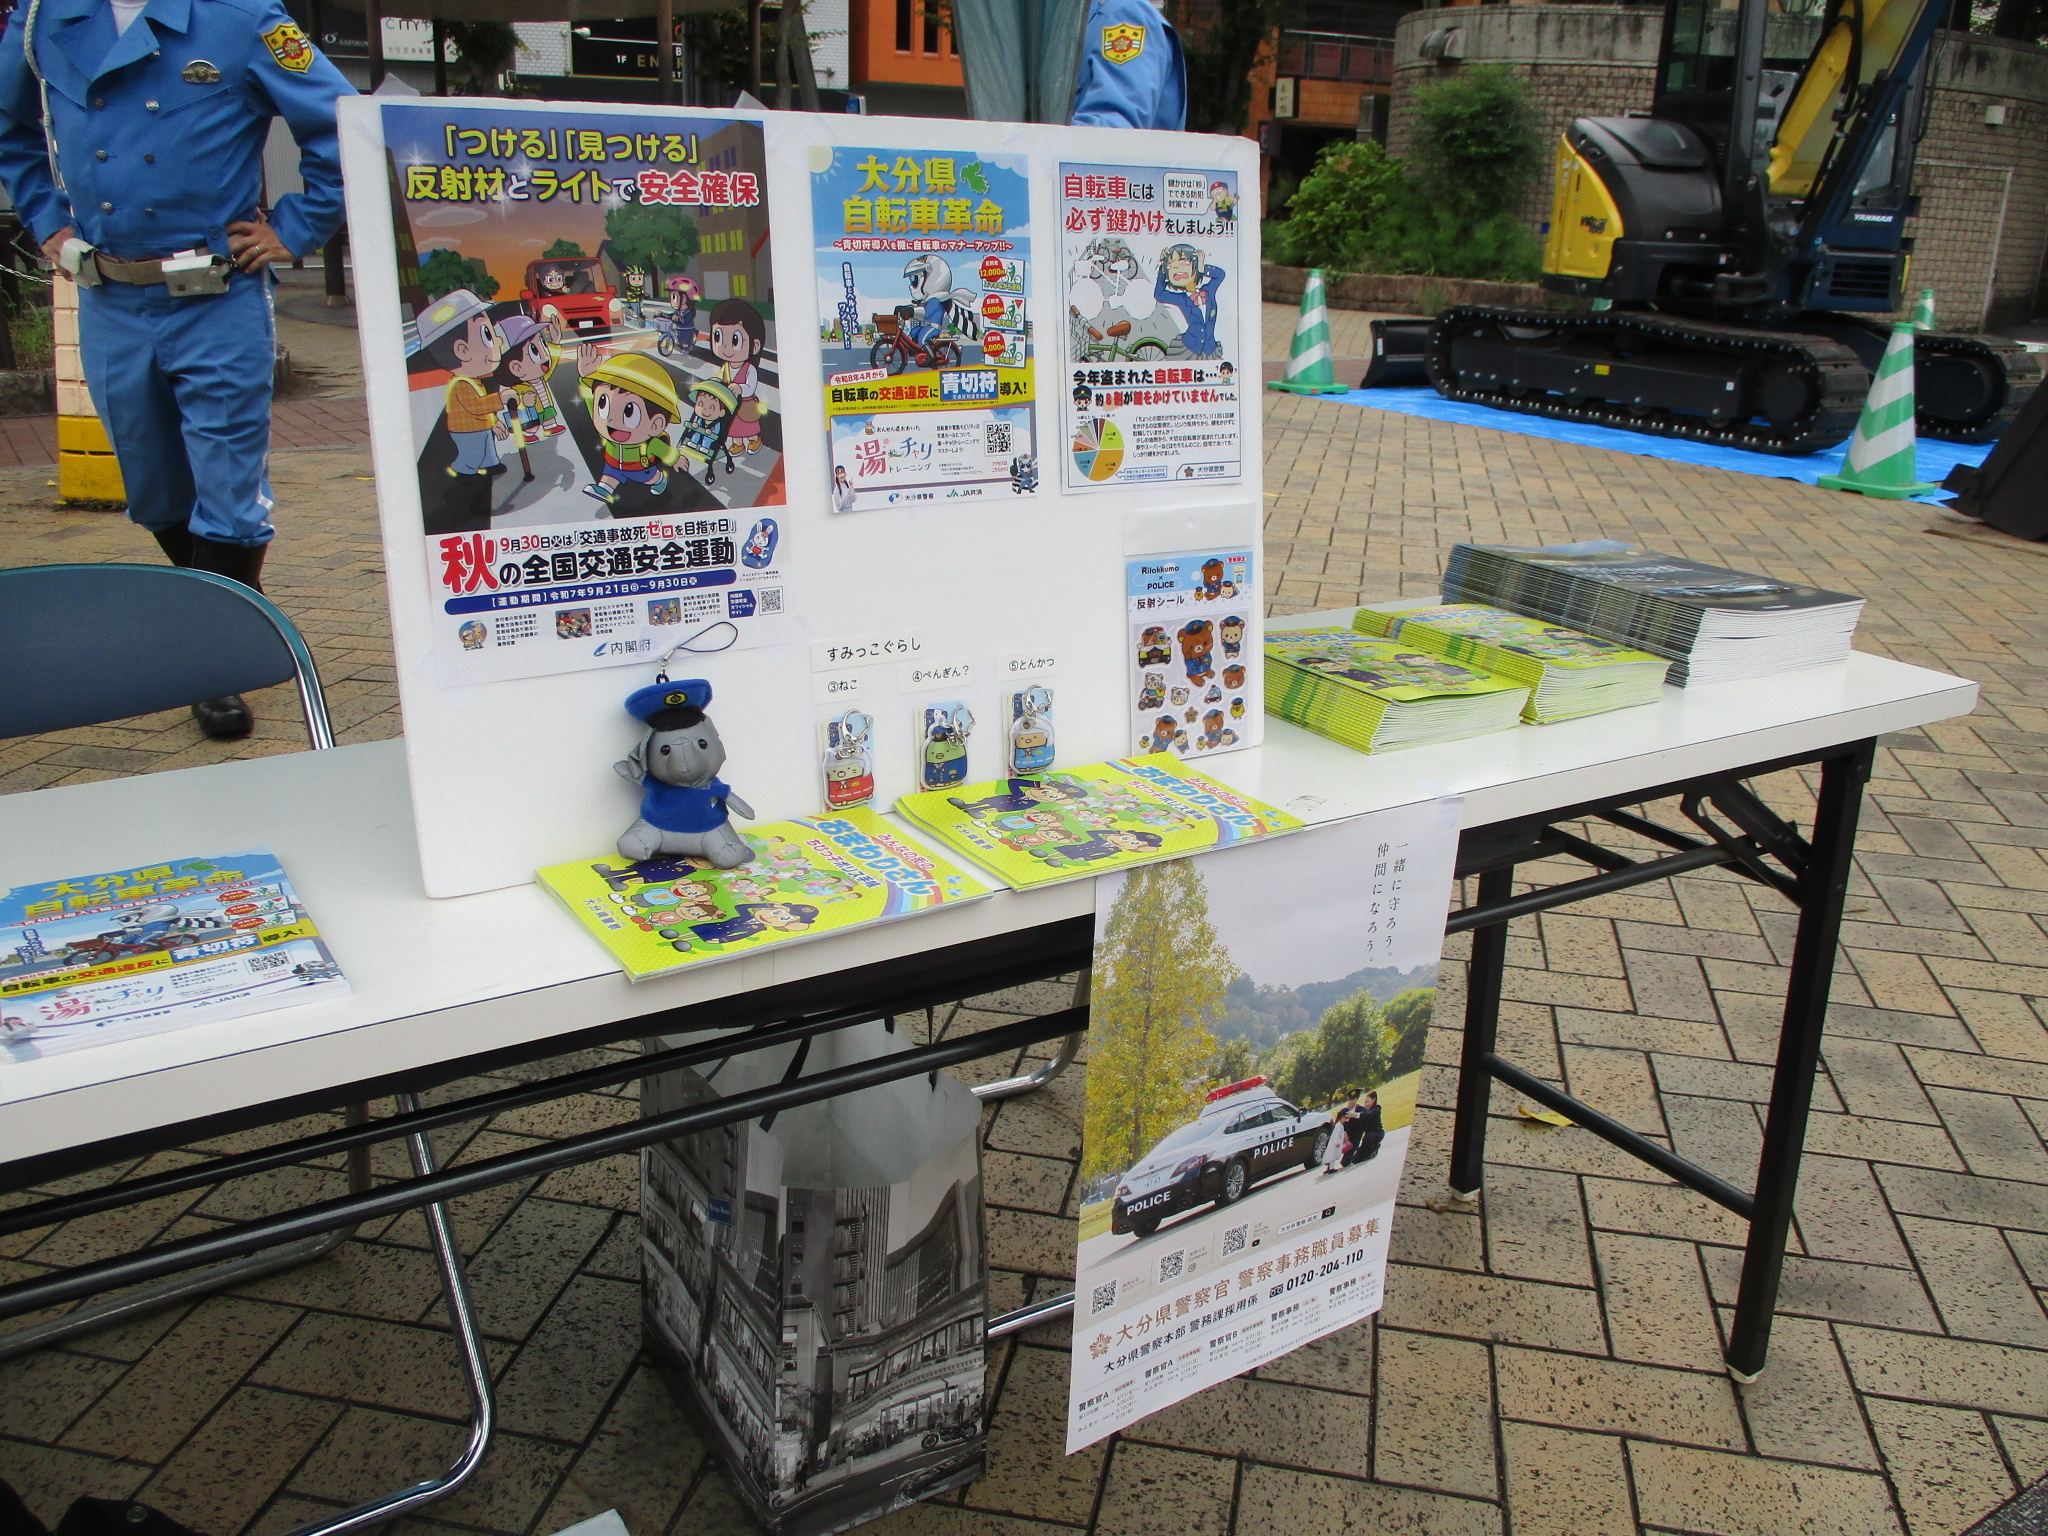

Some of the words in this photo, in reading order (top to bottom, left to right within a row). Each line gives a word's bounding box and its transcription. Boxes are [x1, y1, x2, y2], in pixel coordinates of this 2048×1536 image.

[616, 55, 627, 64] 1F
[445, 124, 699, 164] 「つける」「見つける」
[406, 166, 760, 206] 反射材とライトで安全確保
[857, 155, 956, 194] 大分県
[1064, 173, 1155, 200] 自転車には
[1168, 190, 1205, 199] でできる防犯
[843, 195, 1003, 235] 自転車革命
[1066, 206, 1235, 236] 必ず鍵かけをしましょう!!
[1854, 213, 1893, 223] YANMAR
[831, 386, 939, 402] 自転車の交通違反に
[941, 371, 997, 395] 青切符
[835, 370, 885, 384] 令和8年4月から
[889, 462, 931, 473] トレーニング
[1142, 565, 1180, 574] Rilakkuma
[1147, 581, 1175, 590] POLICE
[1137, 595, 1185, 609] 反射シール
[610, 639, 651, 656] 内閣府
[1132, 765, 1257, 827] おまわりさん
[816, 819, 938, 896] おまわりさん
[878, 833, 937, 870] みんなの街の
[25, 871, 245, 918] 自転車革命
[43, 865, 174, 898] 大分県
[1366, 843, 1389, 962] 仲間になろう。
[1384, 843, 1408, 957] 一緒に守ろう。
[1253, 1137, 1294, 1159] POLICE
[1127, 1190, 1171, 1216] POLICE
[1116, 1279, 1231, 1347] 大分県警察官
[1237, 1216, 1380, 1291] 警察事務職員募集
[1103, 1325, 1186, 1375] 大分県警察本部
[1189, 1294, 1258, 1334] 警務課採用係
[1286, 1249, 1364, 1292] 0120-204-110
